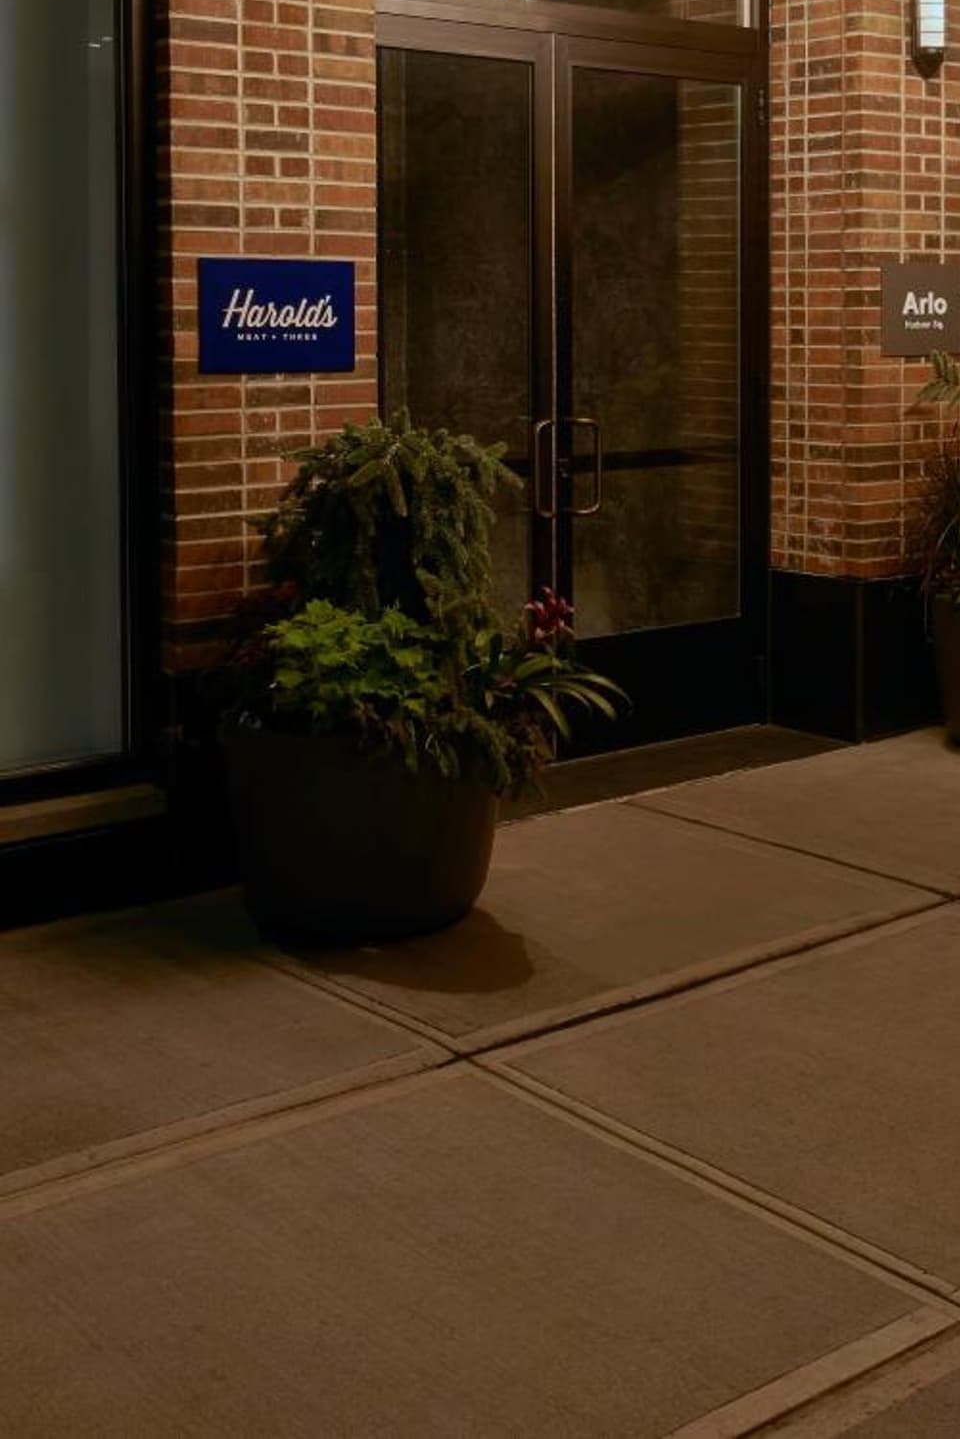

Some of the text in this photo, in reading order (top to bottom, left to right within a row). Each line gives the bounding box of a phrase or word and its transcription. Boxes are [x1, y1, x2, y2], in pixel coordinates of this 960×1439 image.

[221, 288, 338, 328] Harold's
[902, 291, 948, 315] Arlo
[237, 333, 267, 341] MEAT
[283, 333, 318, 341] THREE
